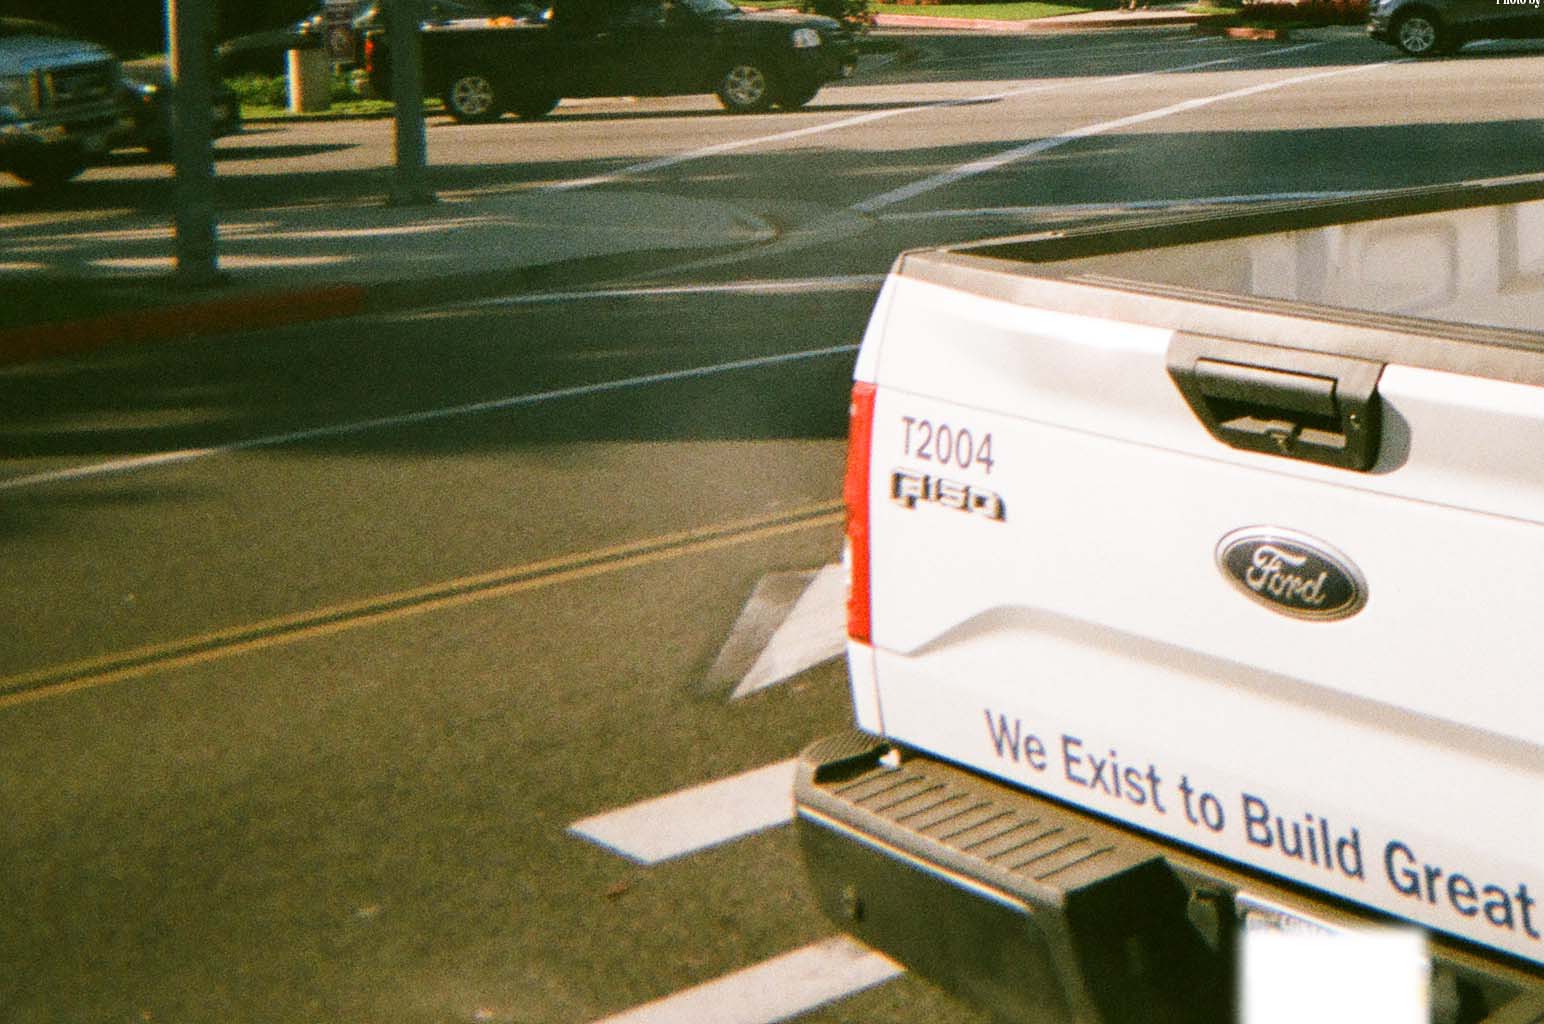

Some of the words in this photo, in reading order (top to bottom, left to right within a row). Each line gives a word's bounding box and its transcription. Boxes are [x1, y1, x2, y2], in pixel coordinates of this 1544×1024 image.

[902, 415, 995, 475] T2004
[1246, 544, 1328, 605] Ford
[984, 708, 1048, 772] We
[1061, 733, 1167, 814] Exist
[1177, 773, 1226, 832] to
[1241, 792, 1365, 881] Build
[1384, 839, 1541, 941] Great
